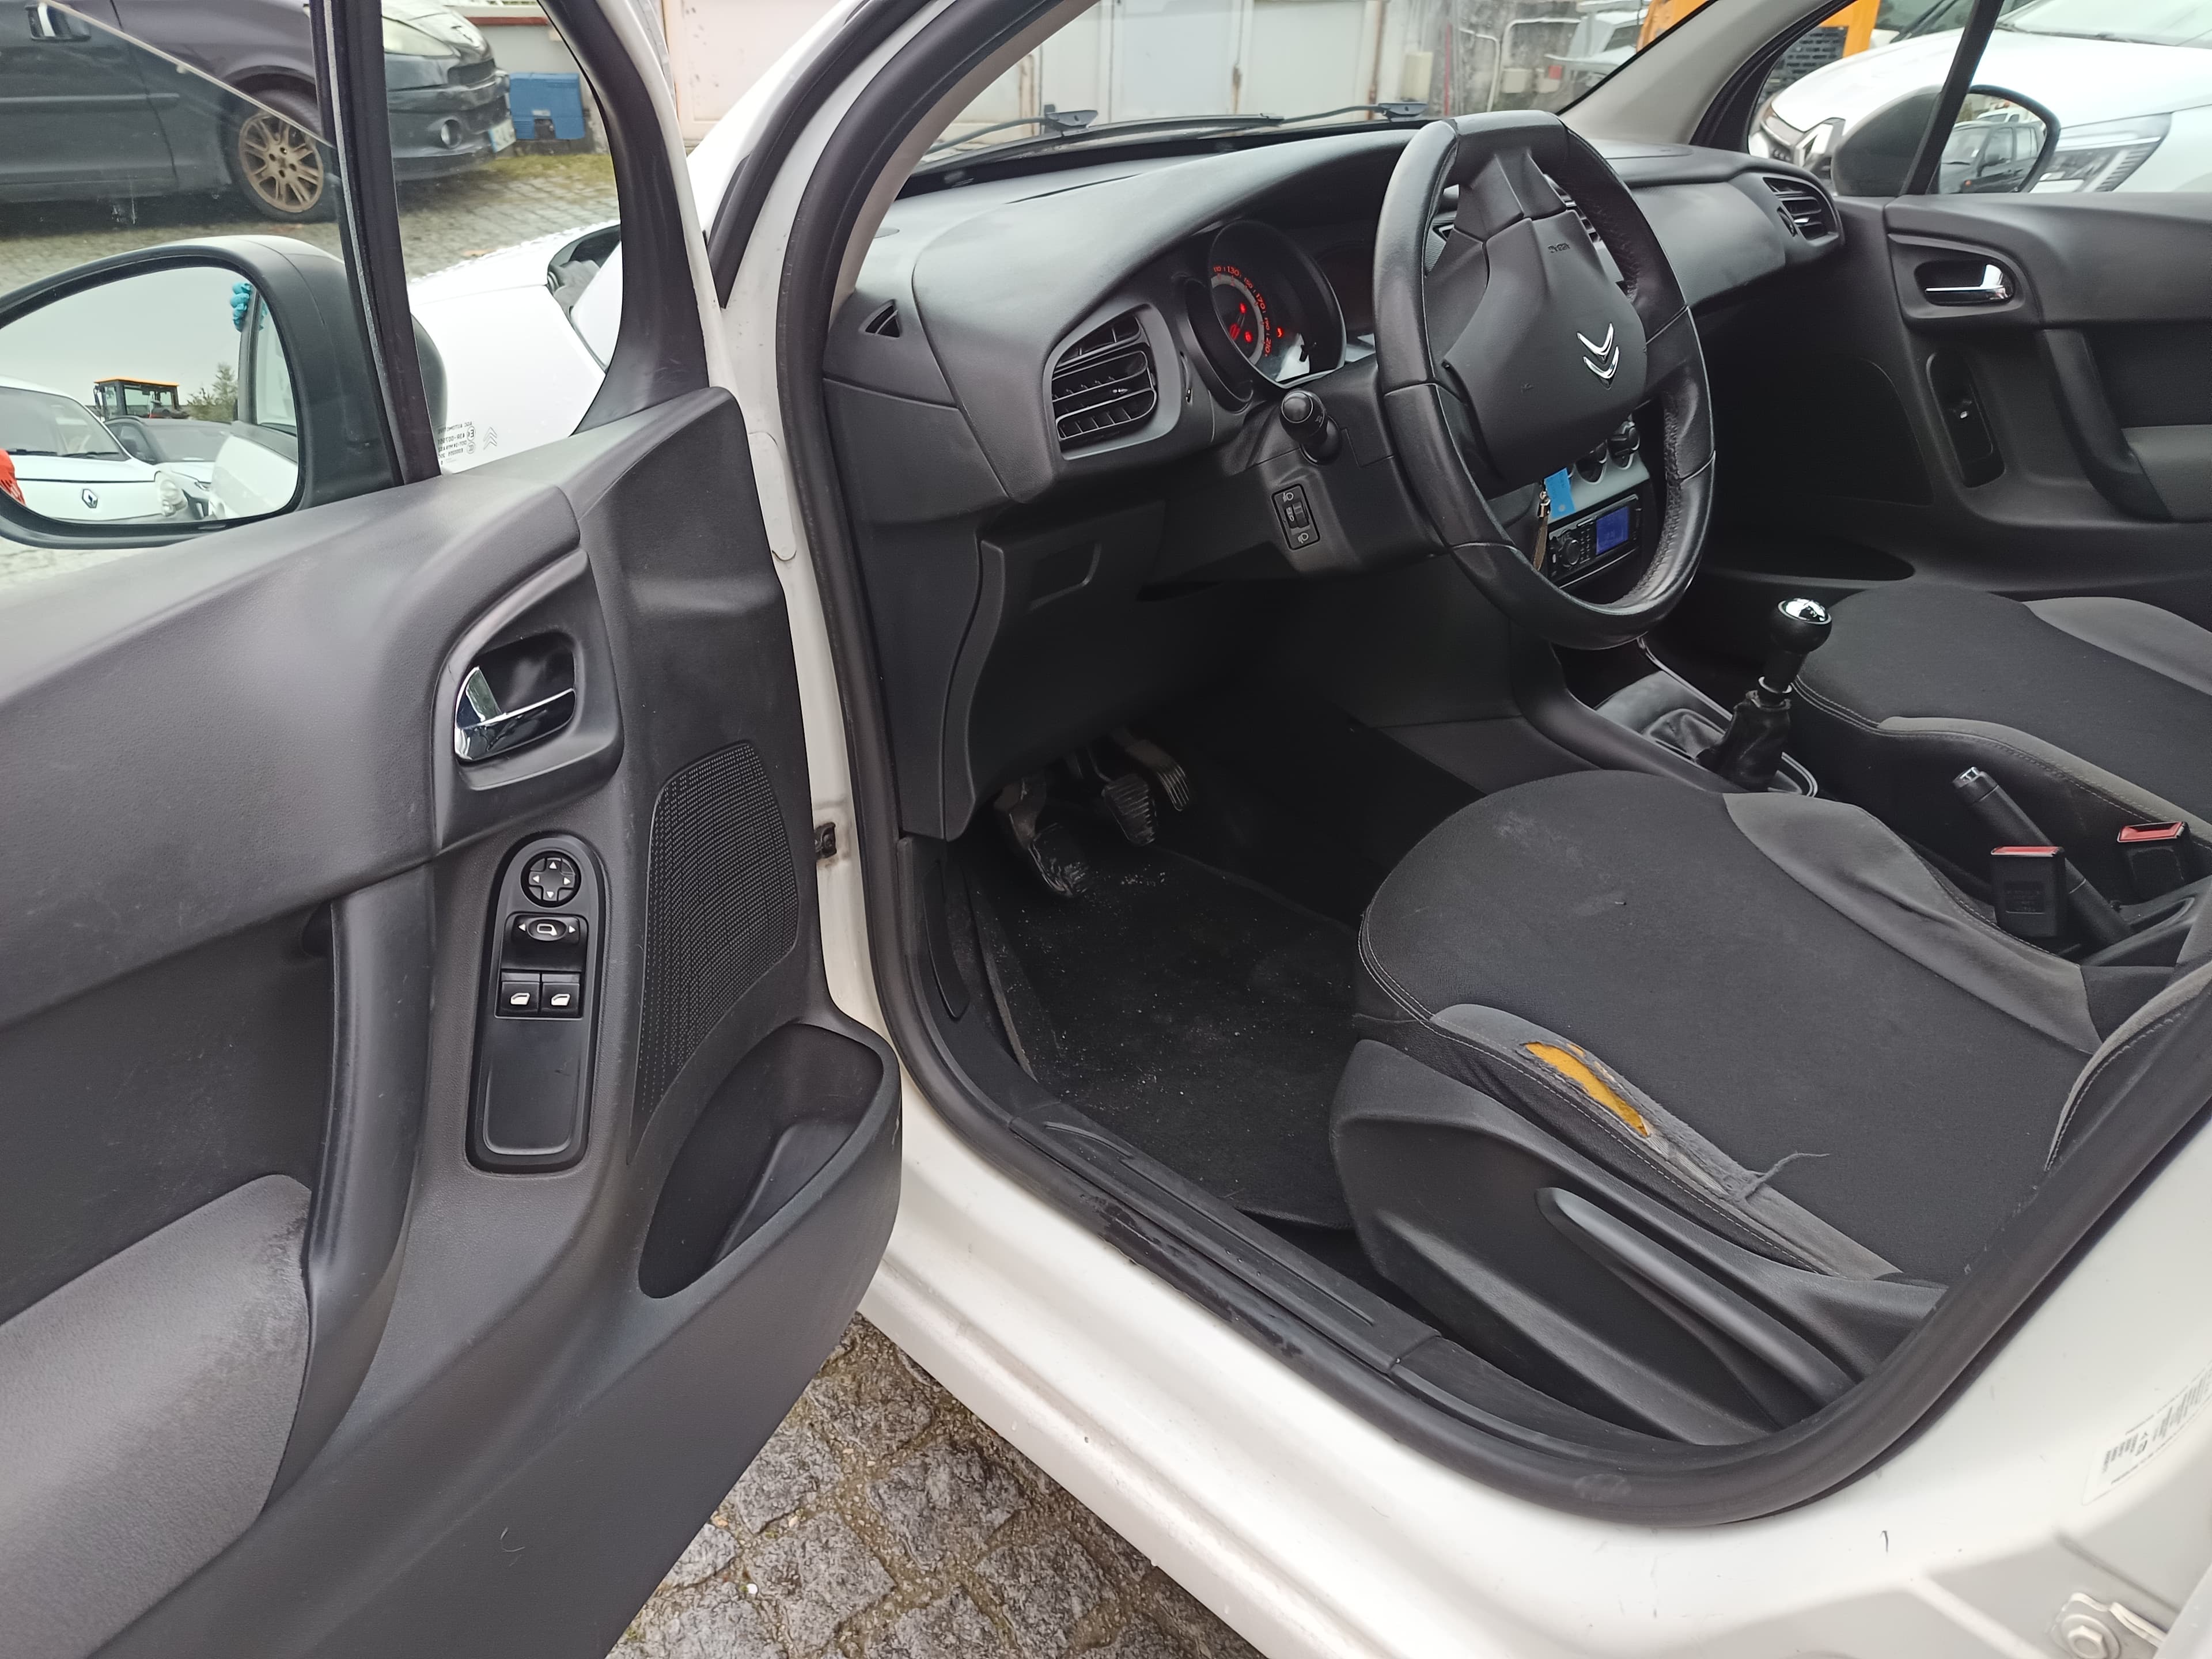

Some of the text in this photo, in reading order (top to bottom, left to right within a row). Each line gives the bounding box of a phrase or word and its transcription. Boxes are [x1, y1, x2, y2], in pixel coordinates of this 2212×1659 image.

[1228, 266, 1240, 276] 130
[1244, 277, 1253, 289] 150
[1256, 293, 1266, 309] 170
